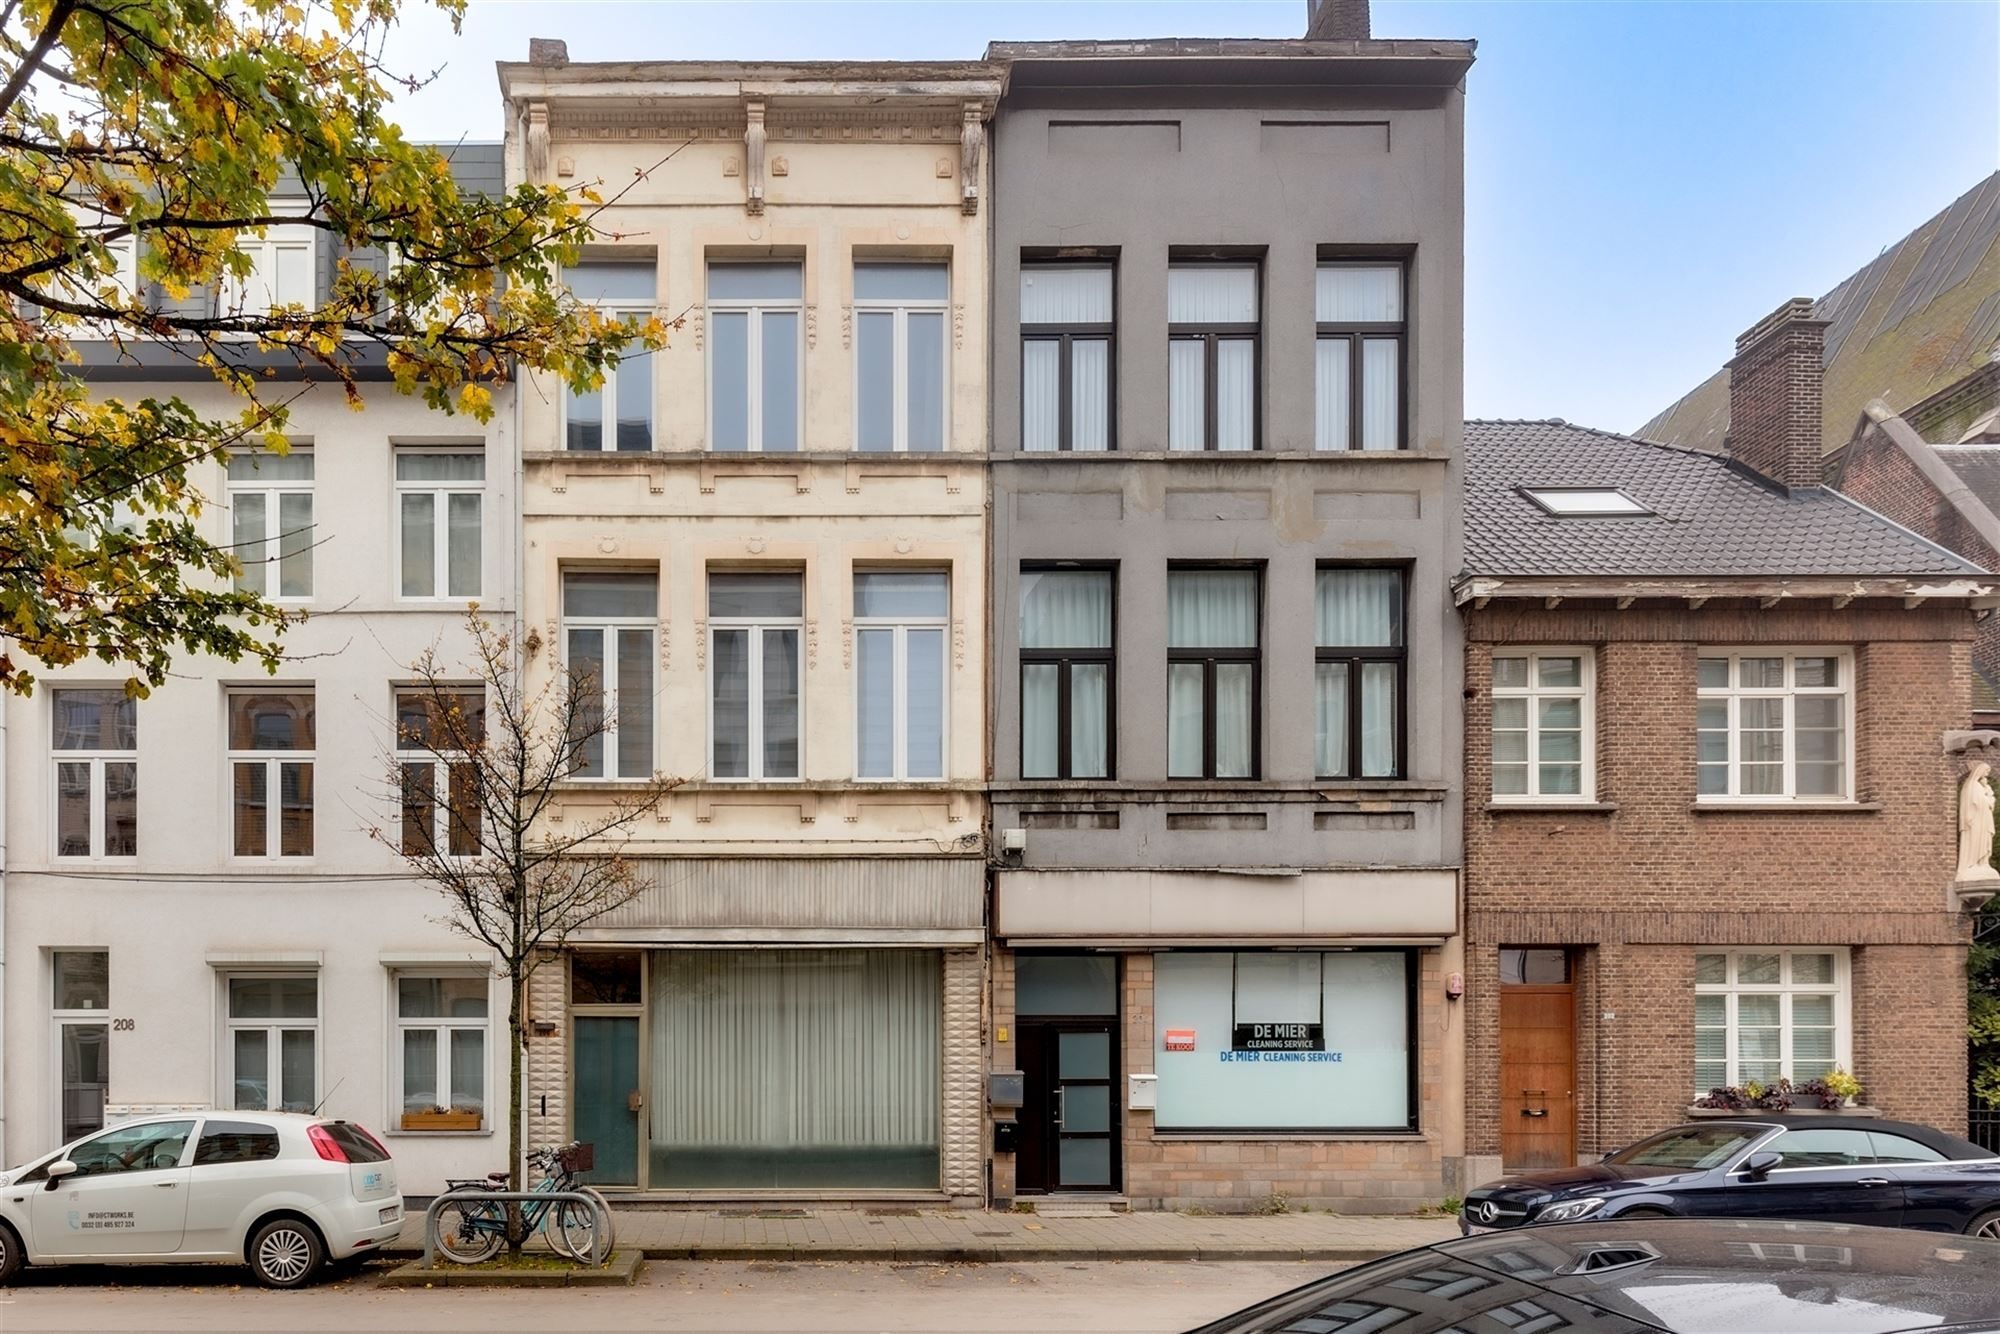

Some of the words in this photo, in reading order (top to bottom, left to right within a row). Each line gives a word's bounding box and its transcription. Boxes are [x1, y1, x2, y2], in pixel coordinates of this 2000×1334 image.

[113, 1018, 135, 1031] 208
[1254, 1024, 1272, 1038] DE
[1274, 1024, 1307, 1038] MIER
[1247, 1040, 1283, 1048] CLEANING
[1284, 1040, 1314, 1048] SERVICE
[1220, 1051, 1233, 1061] DE
[1236, 1051, 1260, 1061] MIER
[1264, 1052, 1306, 1062] CLEANING
[1308, 1052, 1342, 1062] SERVICE
